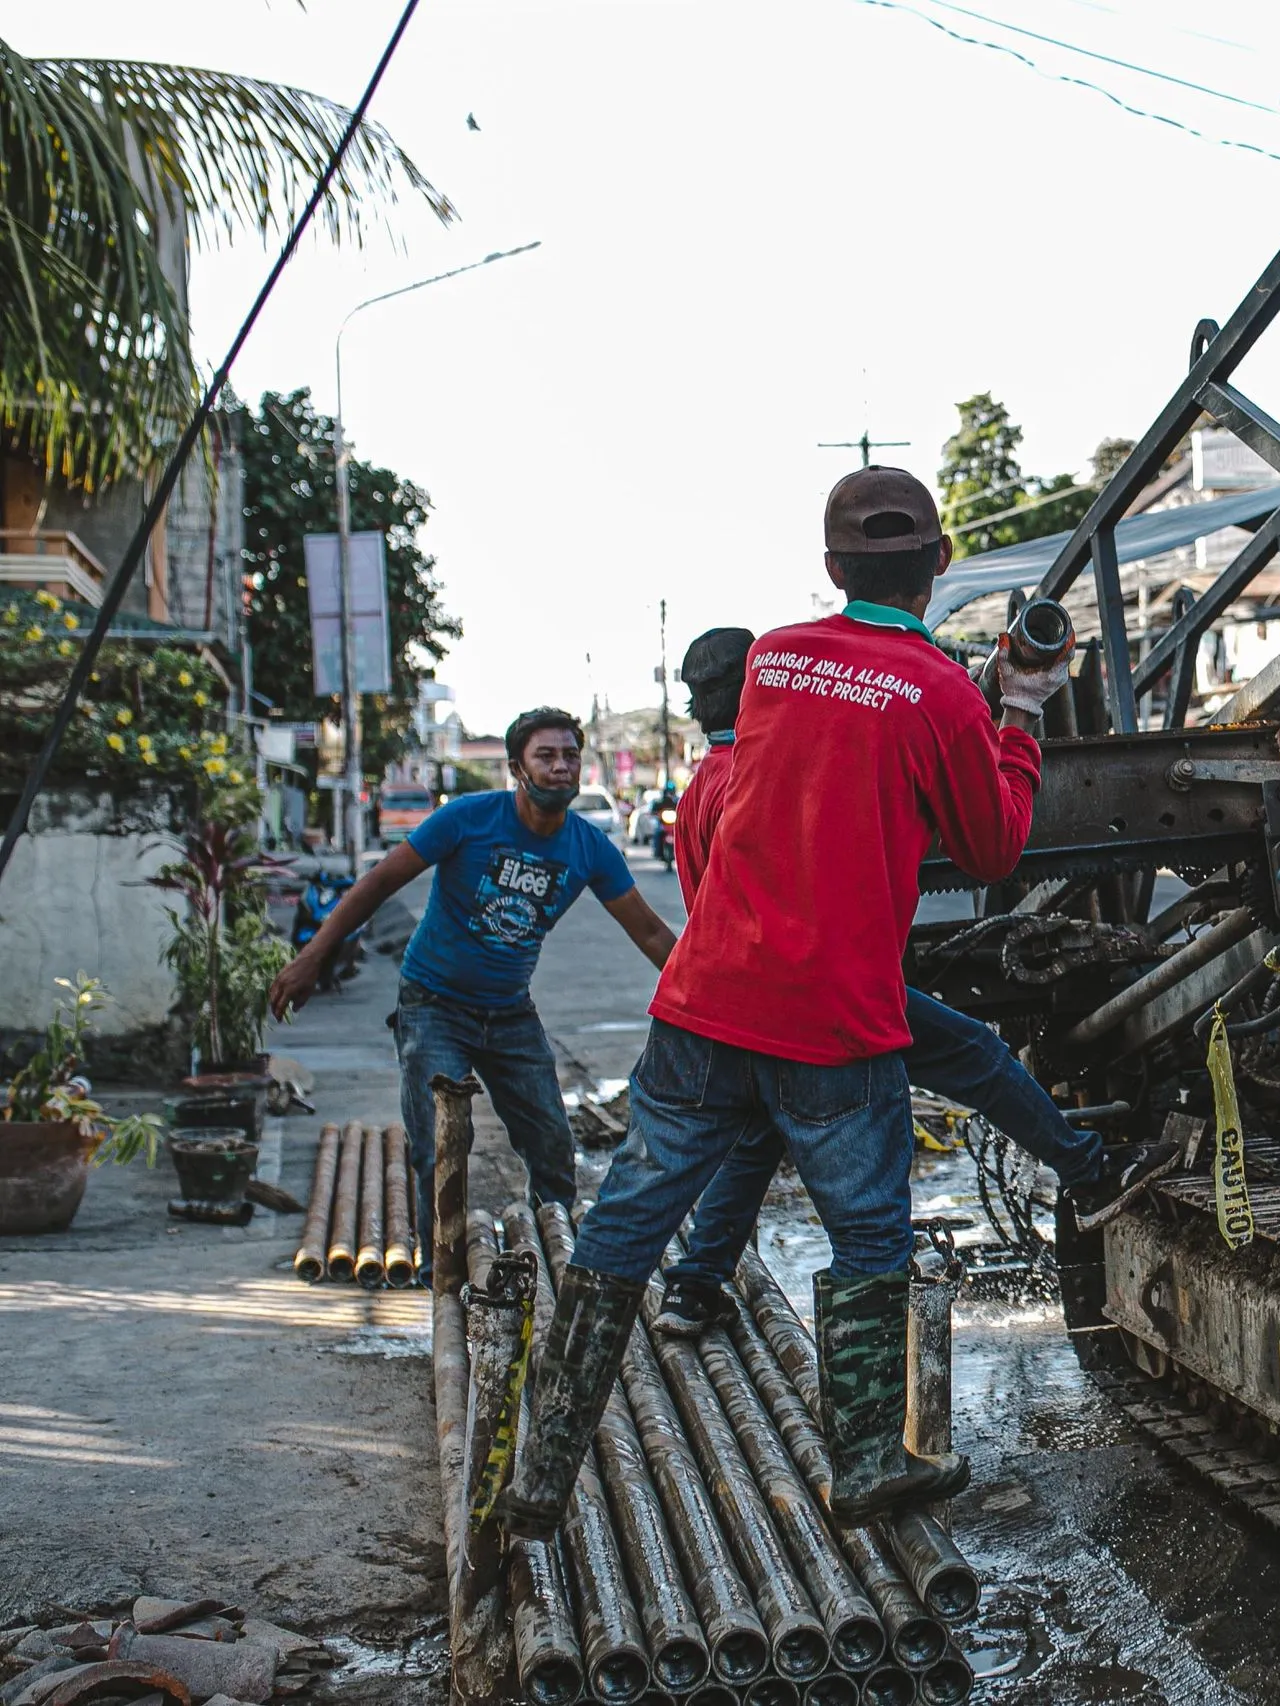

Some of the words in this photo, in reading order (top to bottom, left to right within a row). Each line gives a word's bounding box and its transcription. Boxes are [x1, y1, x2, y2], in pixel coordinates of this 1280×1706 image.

[751, 651, 813, 671] BARANGAY
[812, 660, 854, 681] AYALA
[854, 668, 922, 705] ALABANG
[756, 669, 790, 689] FIBER
[791, 674, 832, 697] OPTIC
[830, 681, 893, 712] PROJECT
